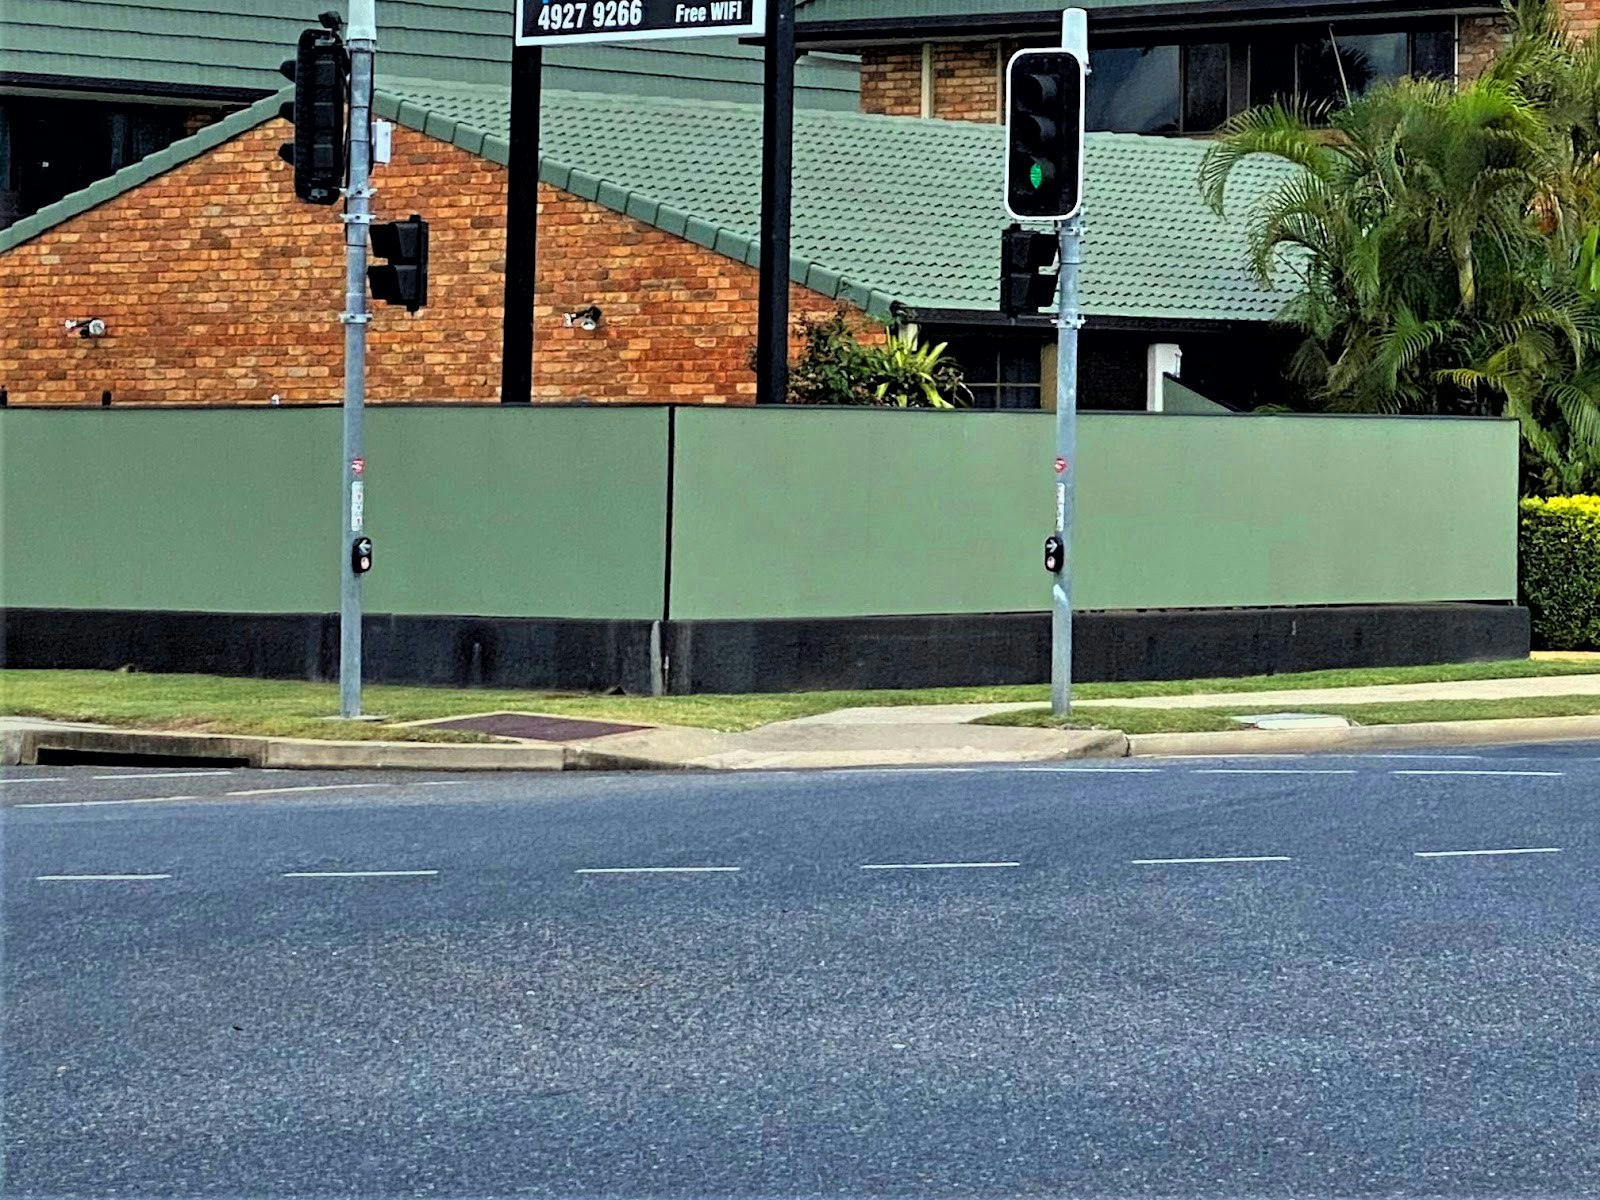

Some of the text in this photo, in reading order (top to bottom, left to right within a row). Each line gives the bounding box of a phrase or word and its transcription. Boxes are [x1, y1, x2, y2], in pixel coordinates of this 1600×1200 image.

[538, 0, 642, 30] 4927 9266
[675, 0, 742, 23] Free WIFI
